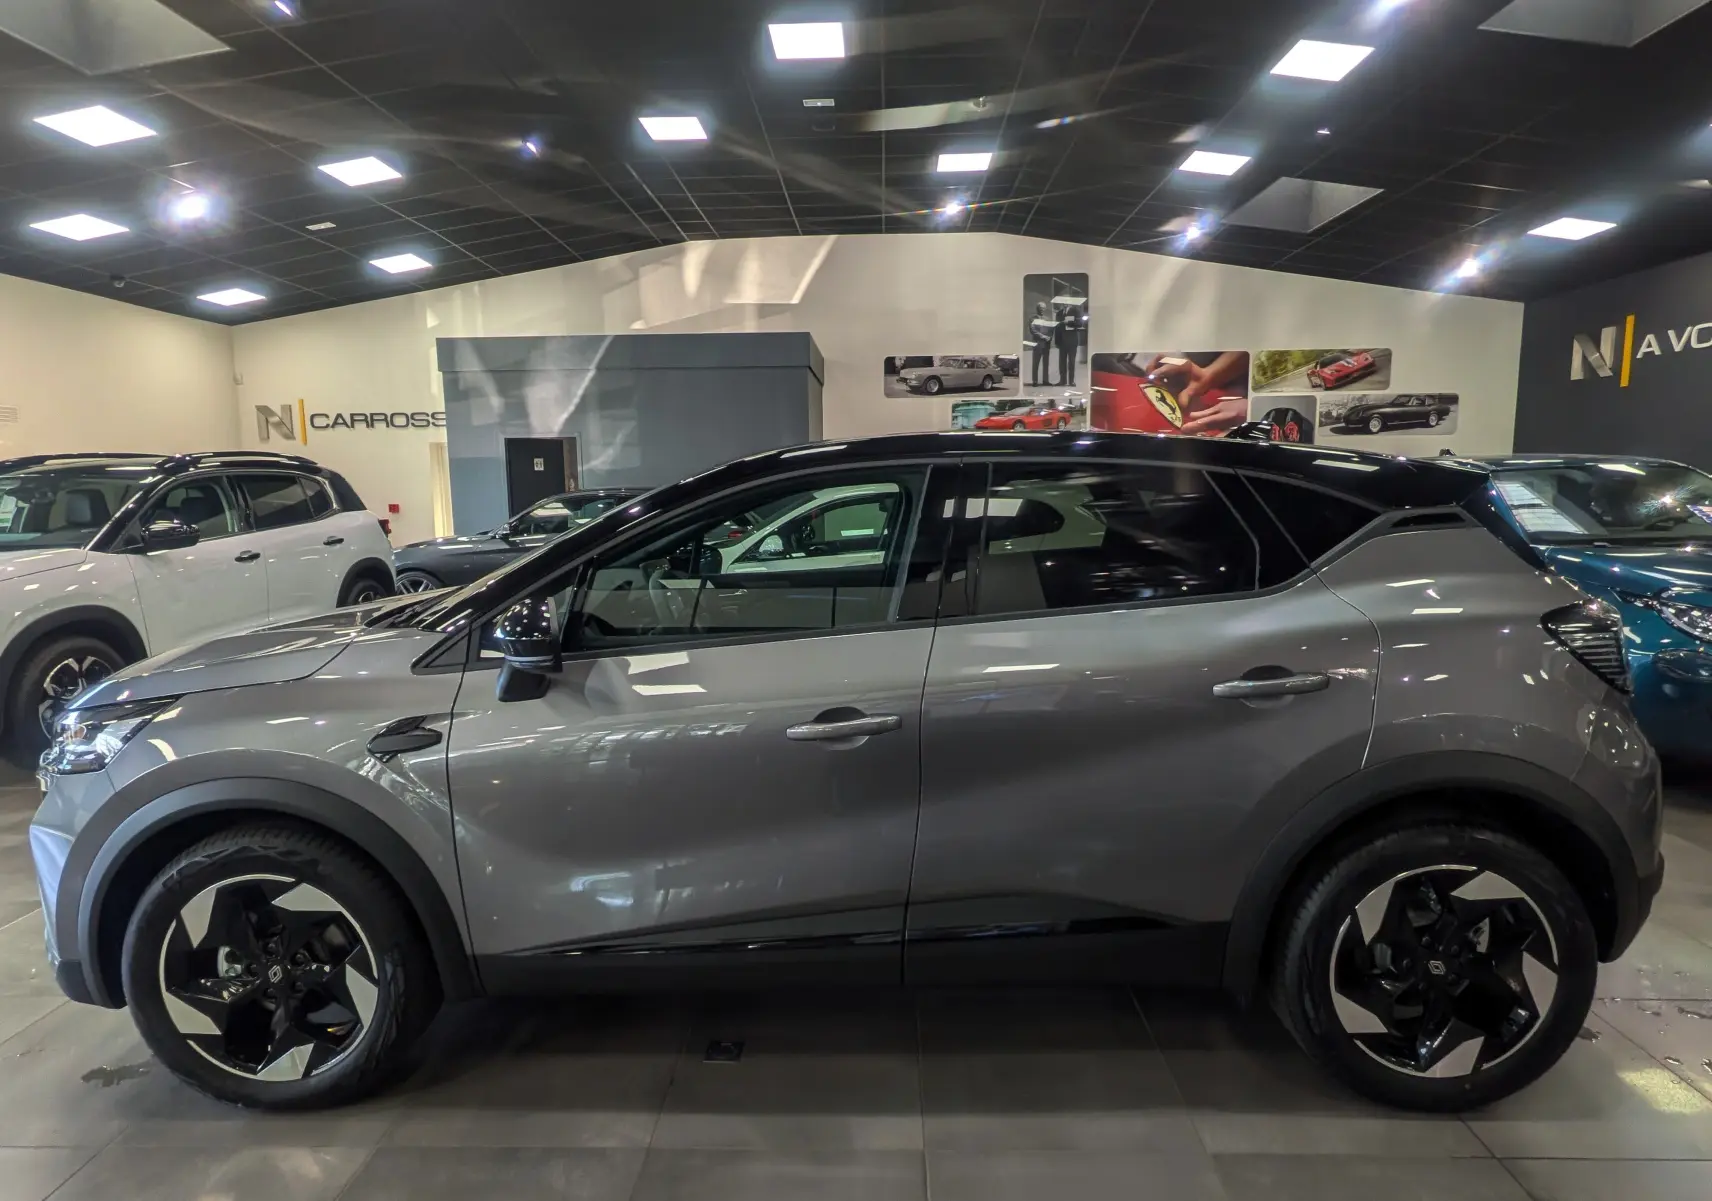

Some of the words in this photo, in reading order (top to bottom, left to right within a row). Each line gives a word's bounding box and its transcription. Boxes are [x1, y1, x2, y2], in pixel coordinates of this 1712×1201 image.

[1570, 326, 1617, 381] N
[1636, 333, 1662, 359] A
[255, 404, 296, 441] N
[309, 411, 446, 430] CARROSS
